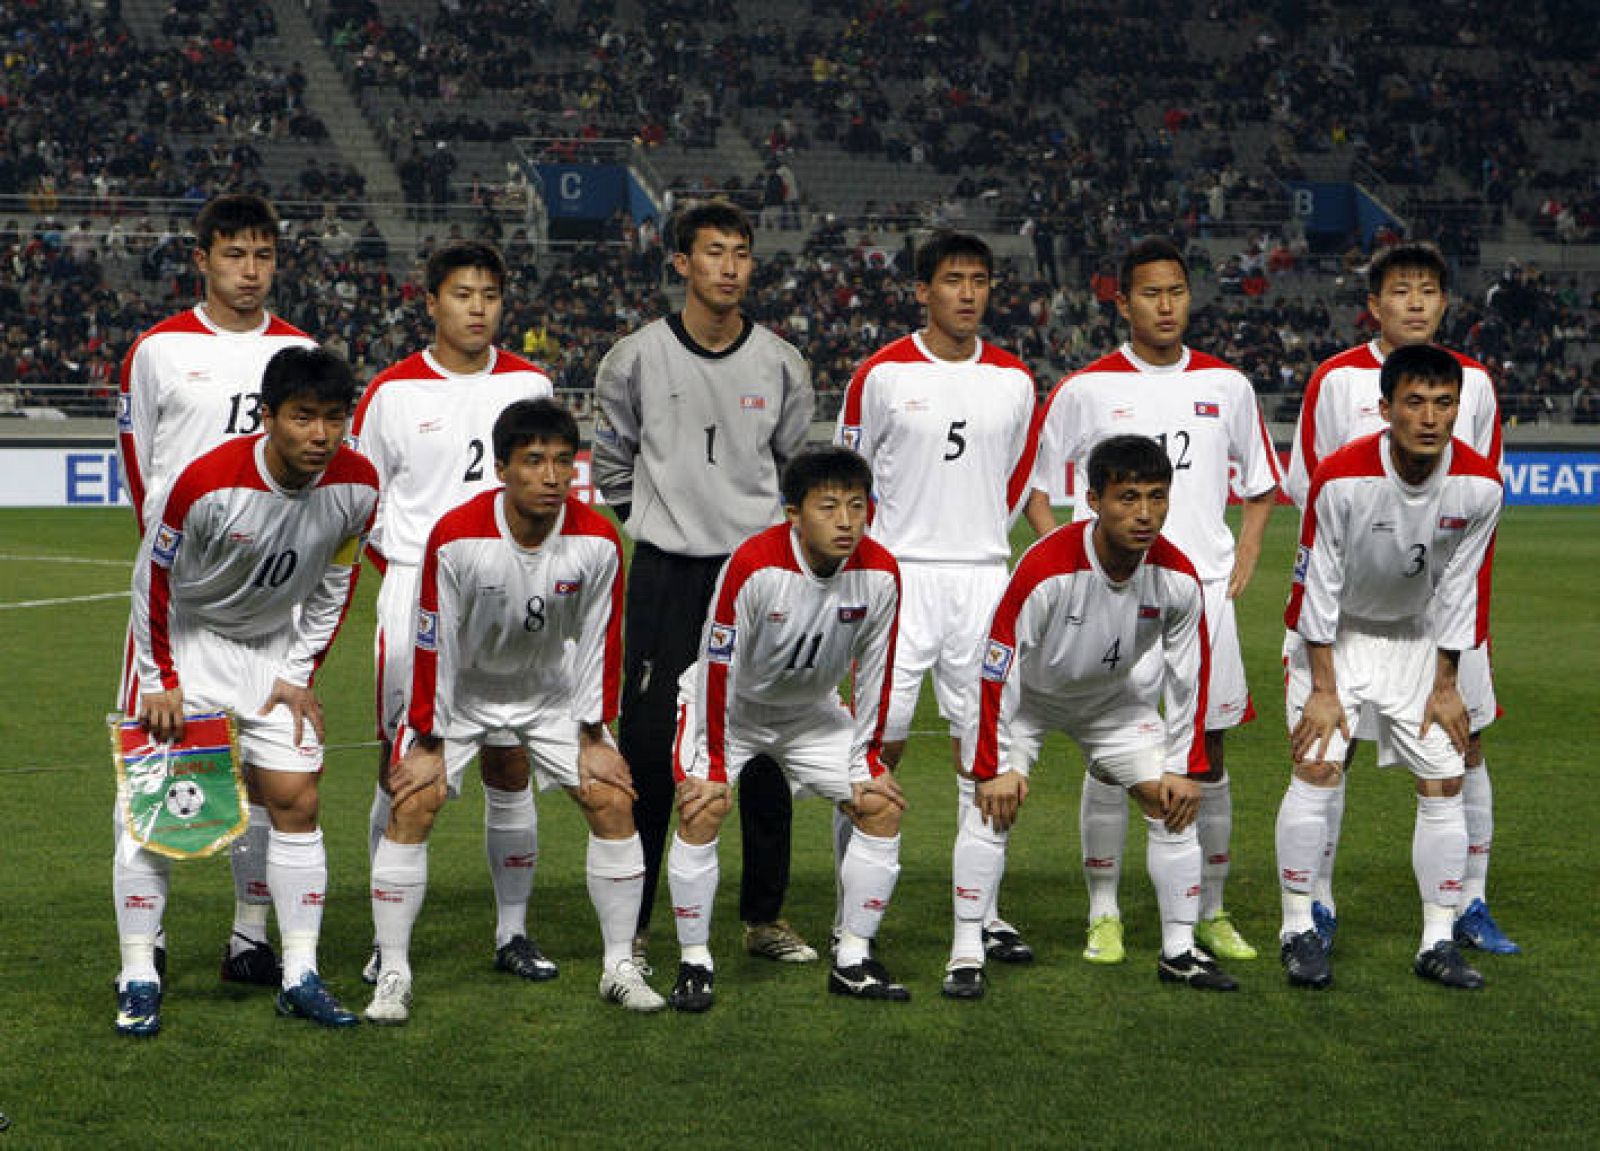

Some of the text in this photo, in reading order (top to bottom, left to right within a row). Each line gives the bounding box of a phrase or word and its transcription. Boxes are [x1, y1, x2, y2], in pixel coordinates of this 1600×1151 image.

[561, 172, 582, 200] C
[1294, 188, 1314, 215] B
[224, 392, 262, 434] 13
[703, 424, 716, 466] 1
[943, 420, 967, 461] 5
[463, 438, 484, 482] 2
[253, 550, 297, 588] 10
[1403, 543, 1427, 578] 3
[525, 595, 545, 632] 8
[785, 632, 824, 670] 11
[1101, 636, 1121, 671] 4
